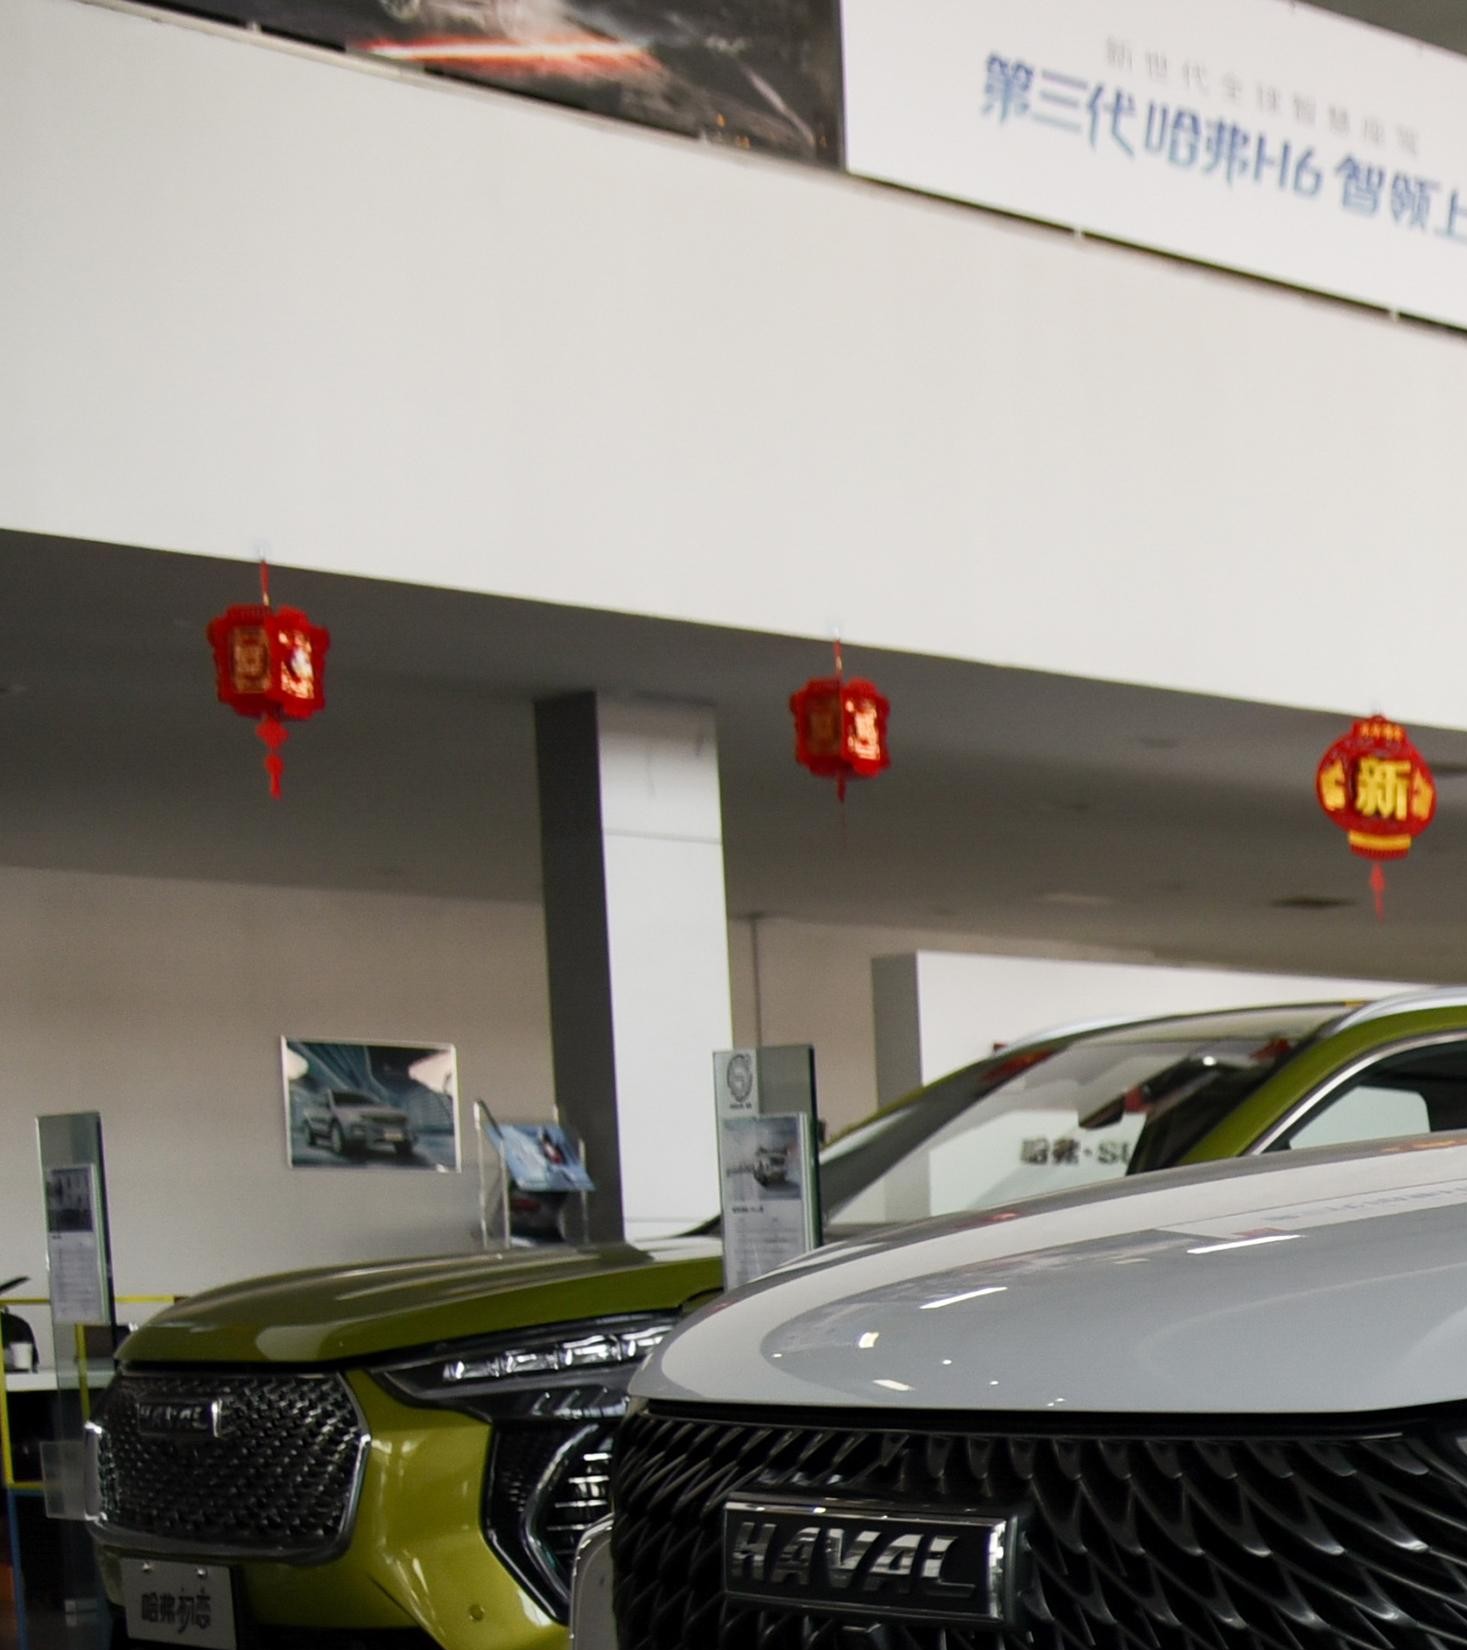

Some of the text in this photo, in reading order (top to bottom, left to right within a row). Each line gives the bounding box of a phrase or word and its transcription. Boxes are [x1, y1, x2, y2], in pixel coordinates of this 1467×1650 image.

[981, 50, 1324, 196] 第三代哈弗H6
[1355, 756, 1411, 821] 新
[731, 1521, 976, 1598] HAVAL
[141, 1585, 212, 1635] 哈弗初恋
